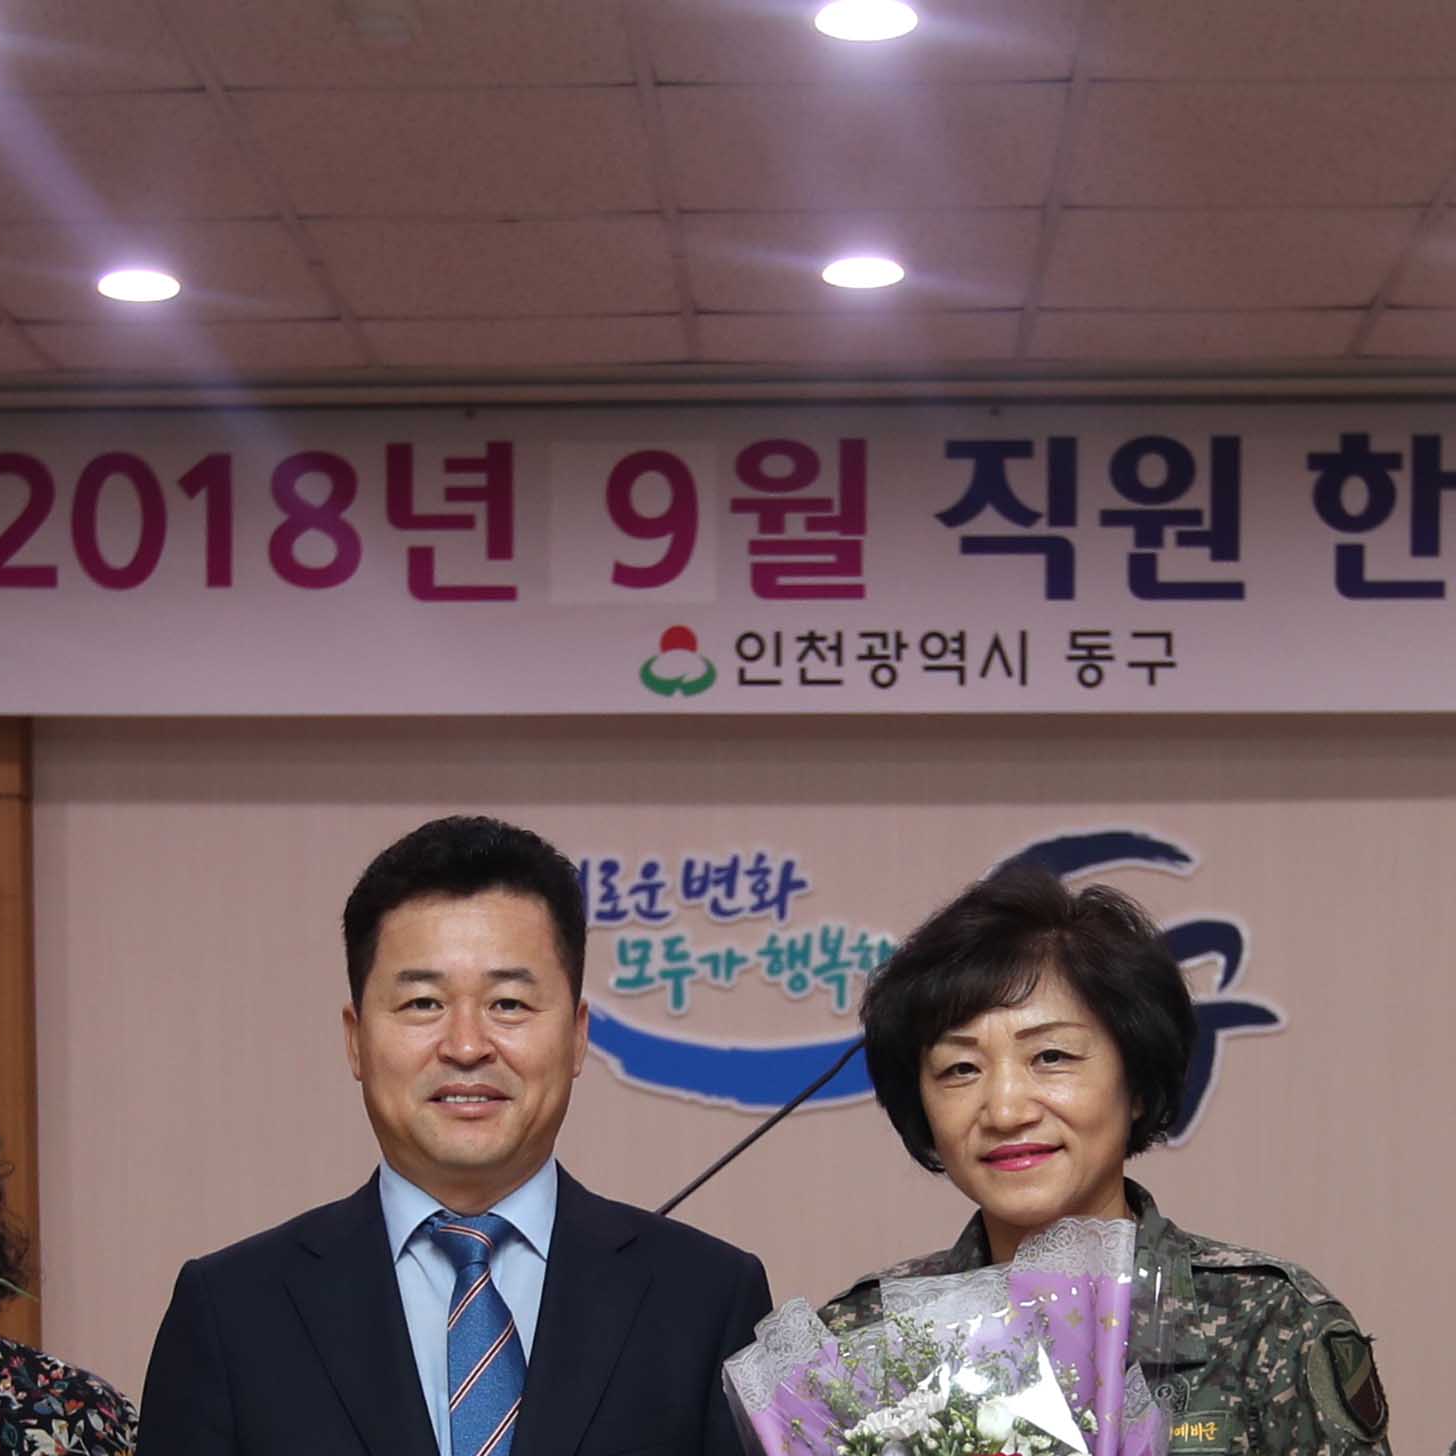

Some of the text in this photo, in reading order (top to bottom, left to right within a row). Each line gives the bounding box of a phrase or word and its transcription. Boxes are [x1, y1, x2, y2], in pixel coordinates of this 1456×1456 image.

[606, 438, 867, 600] 9월
[933, 434, 1246, 600] 직원
[735, 629, 1177, 688] 인천광역시 동구
[577, 853, 807, 921] 로운 변화
[615, 935, 747, 1009] 모두가
